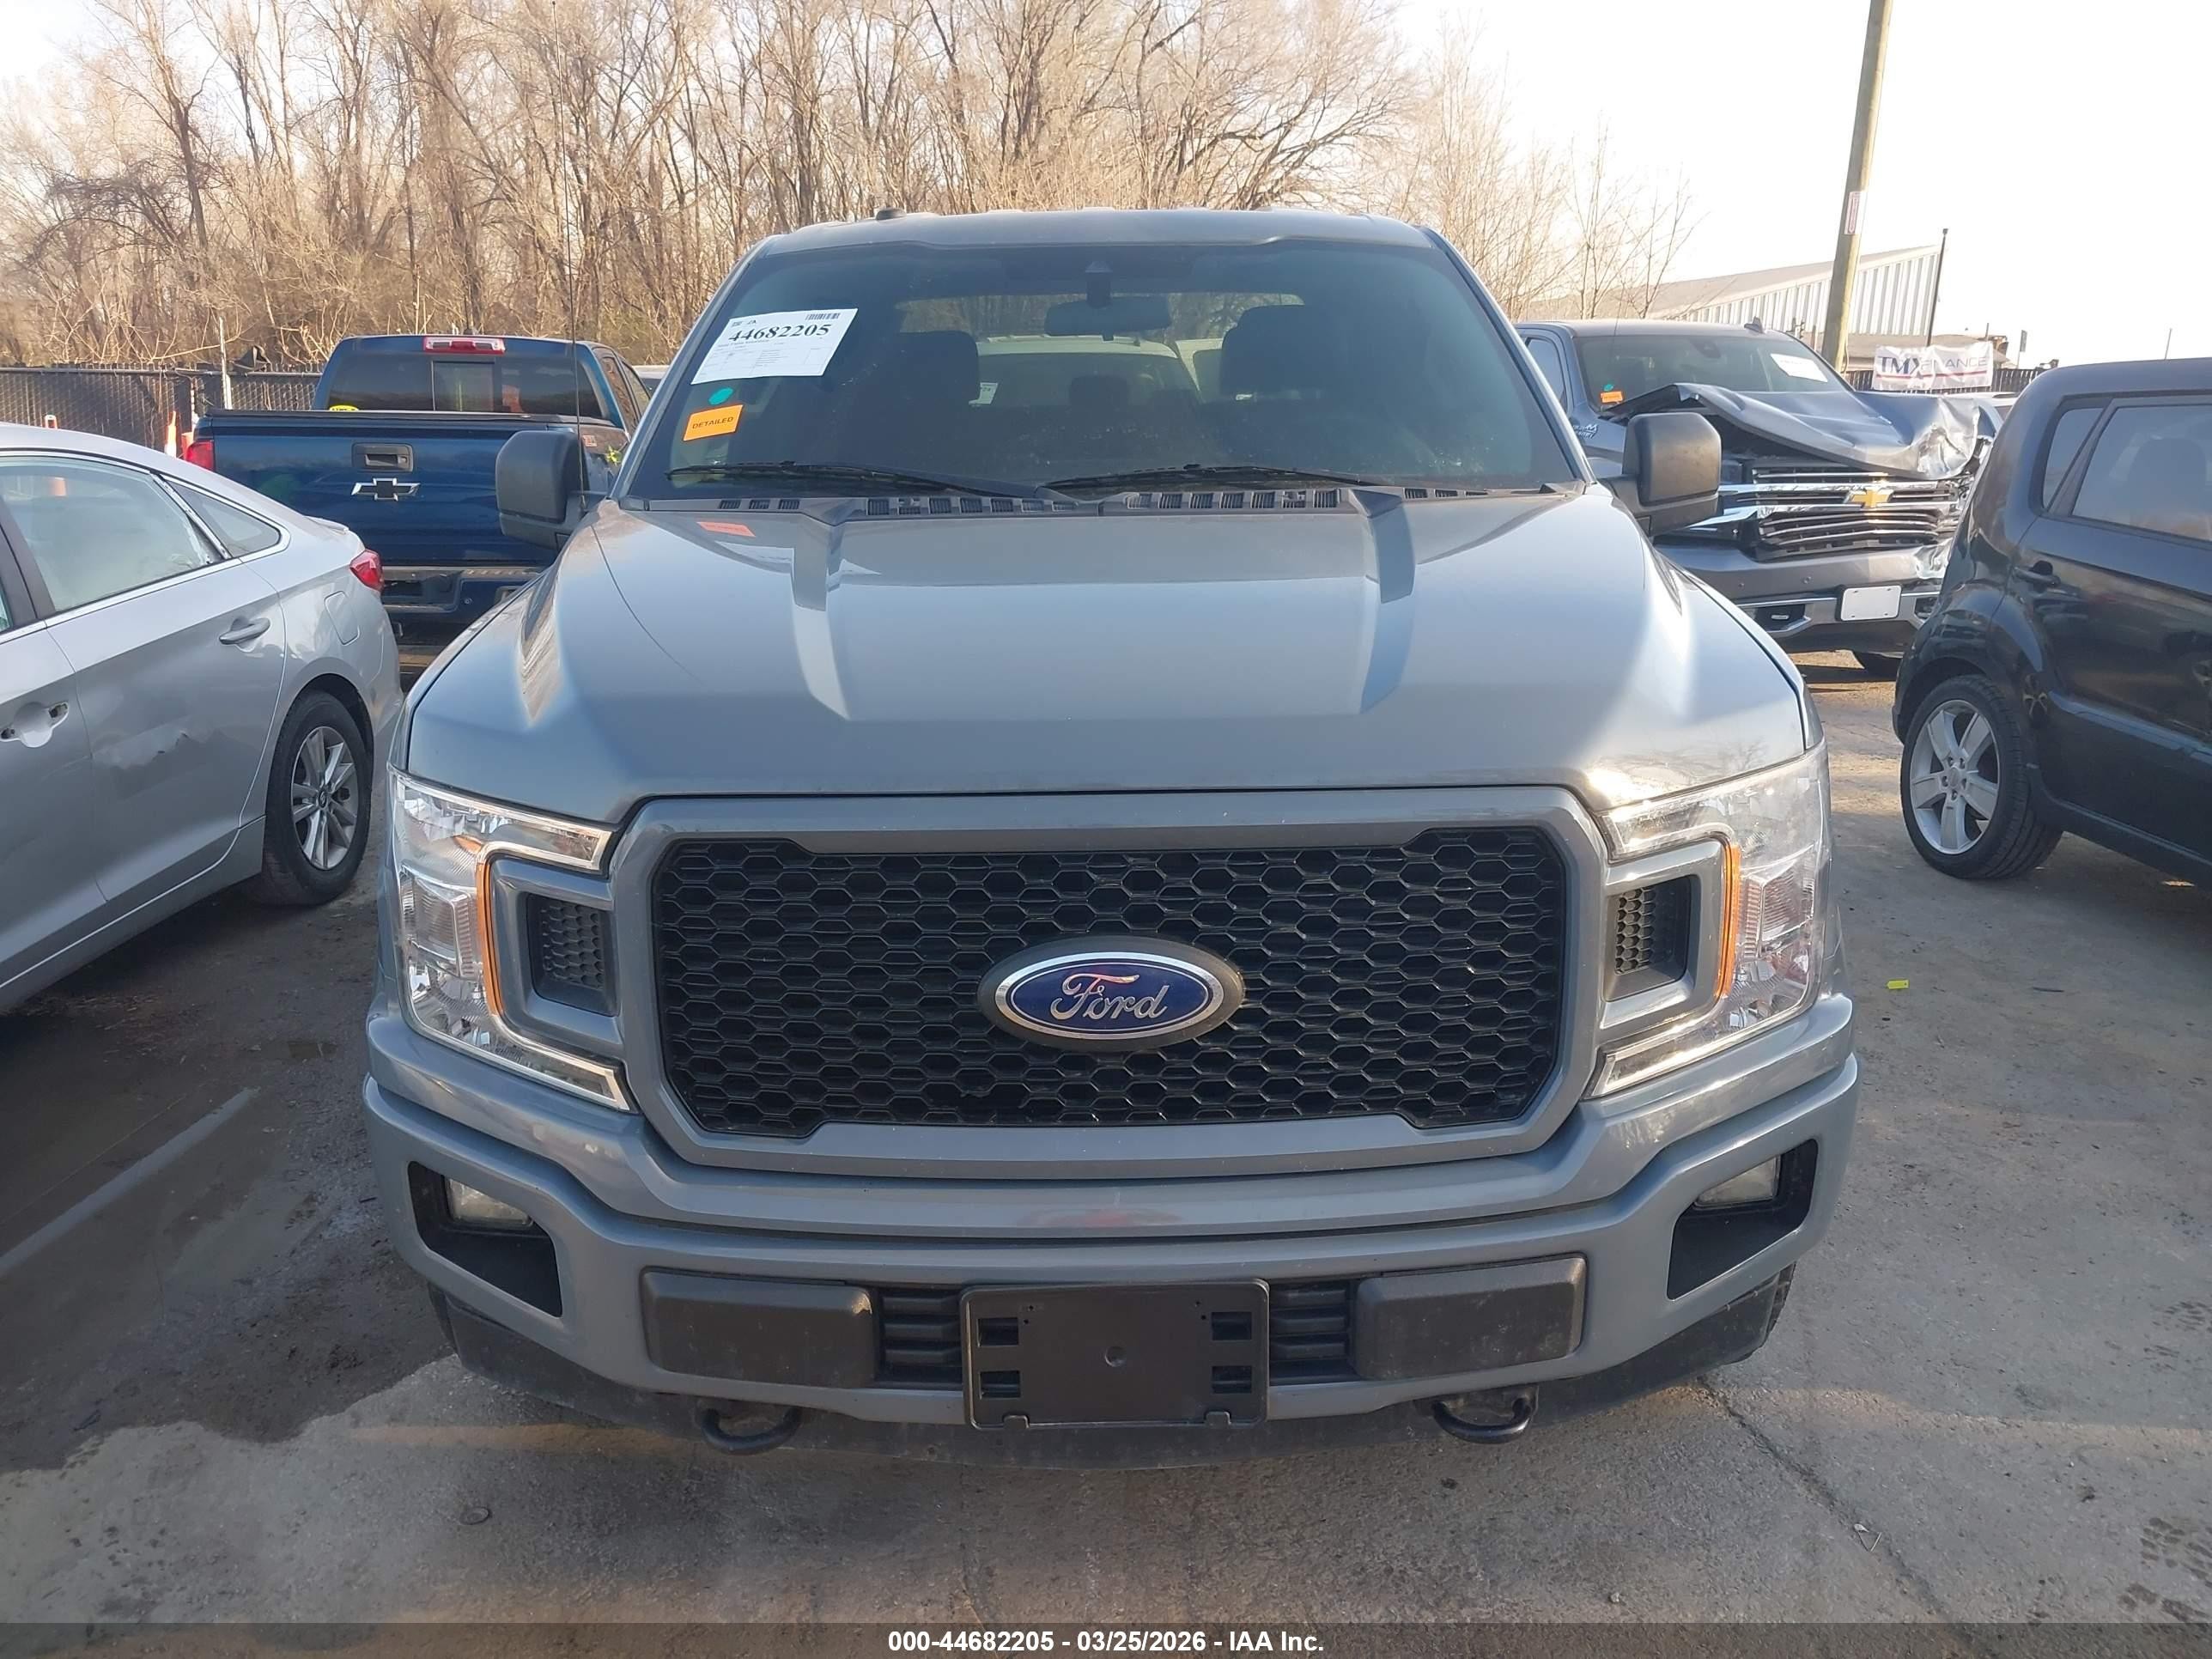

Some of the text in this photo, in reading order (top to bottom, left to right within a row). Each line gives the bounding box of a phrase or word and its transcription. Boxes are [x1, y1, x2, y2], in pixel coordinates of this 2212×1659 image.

[729, 324, 832, 342] 44682205
[1878, 356, 1921, 374] TMX
[692, 416, 734, 429] DETAILED
[1050, 974, 1169, 1020] Ford
